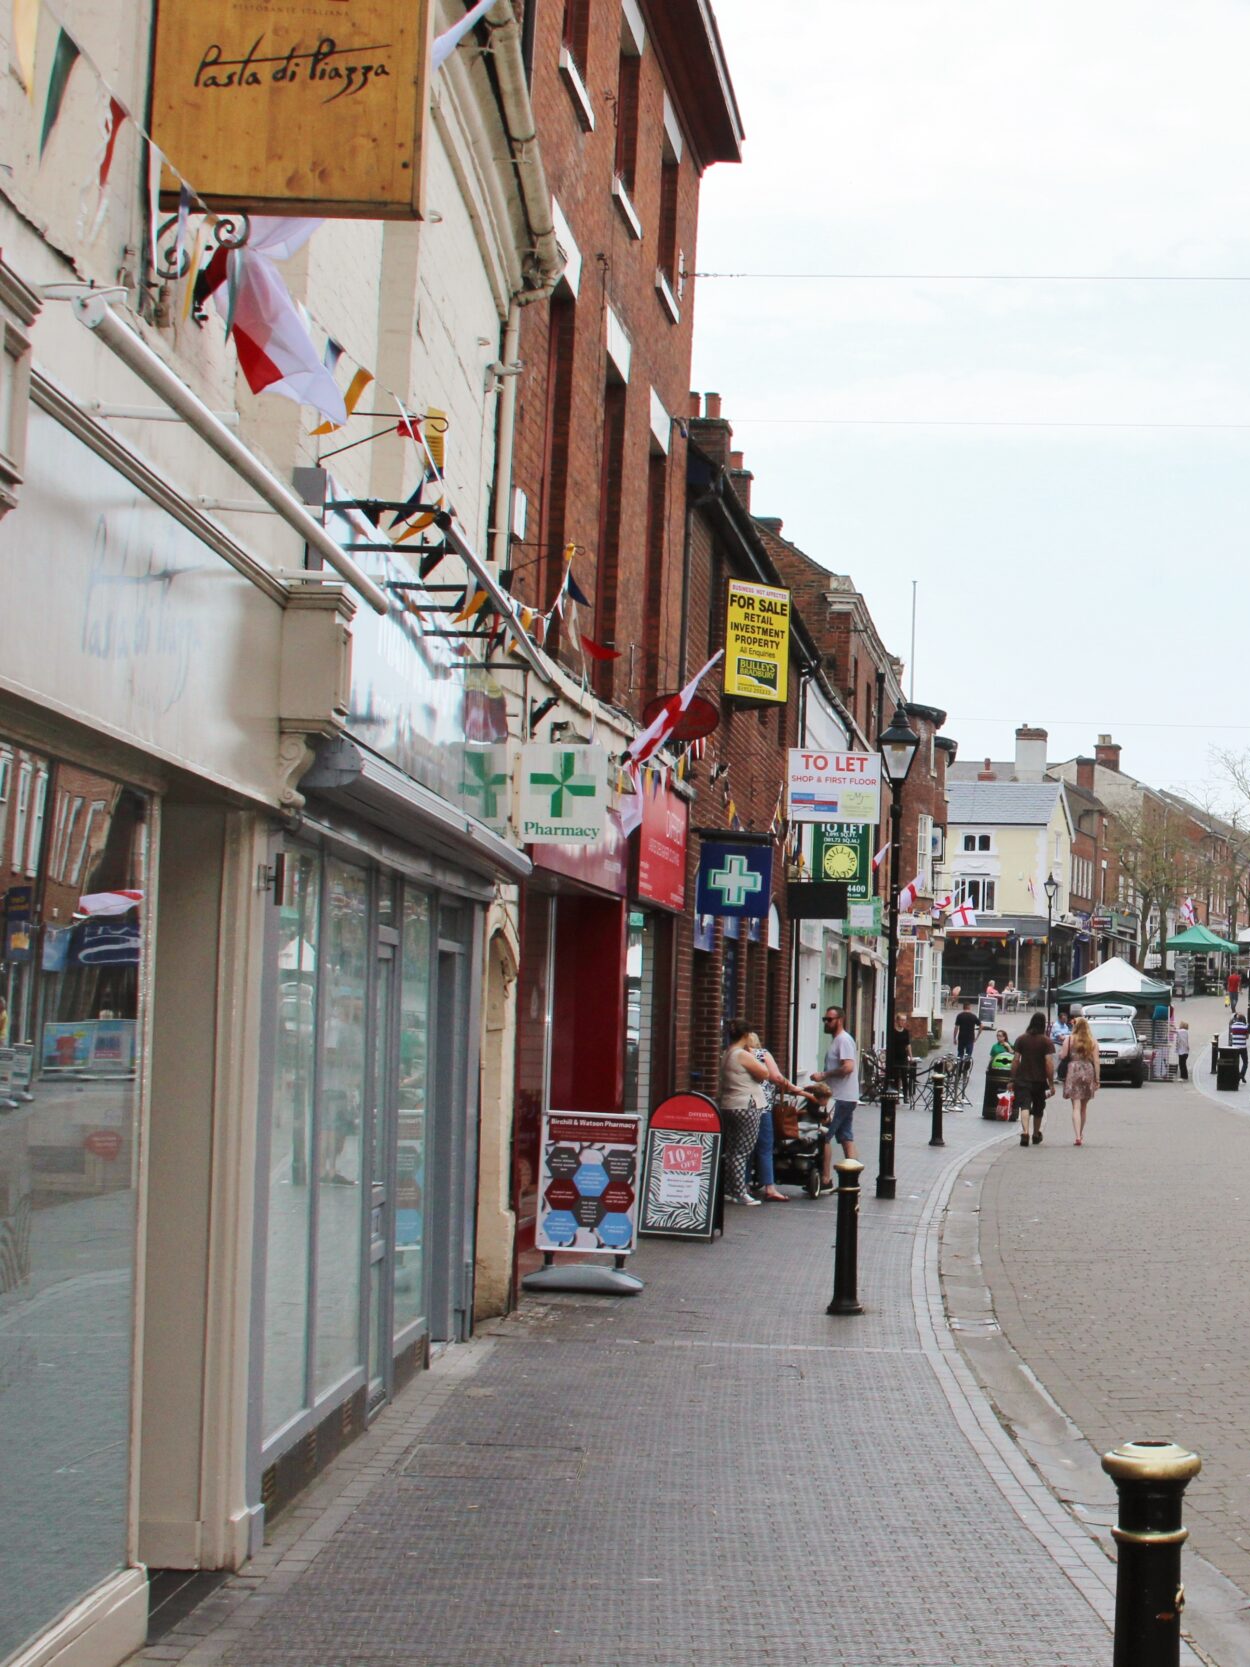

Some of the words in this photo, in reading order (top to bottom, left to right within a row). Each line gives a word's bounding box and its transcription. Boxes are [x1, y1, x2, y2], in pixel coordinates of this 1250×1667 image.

[194, 33, 265, 87] Pasta
[272, 46, 300, 82] di
[309, 37, 391, 104] Piazza
[756, 588, 765, 596] NOT
[729, 594, 755, 611] FOR
[758, 599, 788, 617] SALE
[744, 612, 774, 626] RETAIL
[730, 621, 786, 639] INVESTMENT
[734, 634, 780, 650] PROPERTY
[740, 646, 748, 654] All
[748, 648, 776, 659] Enquiries
[801, 754, 829, 771] TO
[835, 756, 869, 773] LET
[791, 774, 814, 783] SHOP
[824, 776, 847, 785] FIRST
[849, 777, 877, 786] FLOOR
[523, 821, 600, 840] Pharmacy
[843, 823, 865, 834] LET
[579, 1119, 604, 1127] Watson
[604, 1120, 636, 1130] Pharmacy
[667, 1148, 699, 1165] 10%
[680, 1161, 697, 1170] OFF
